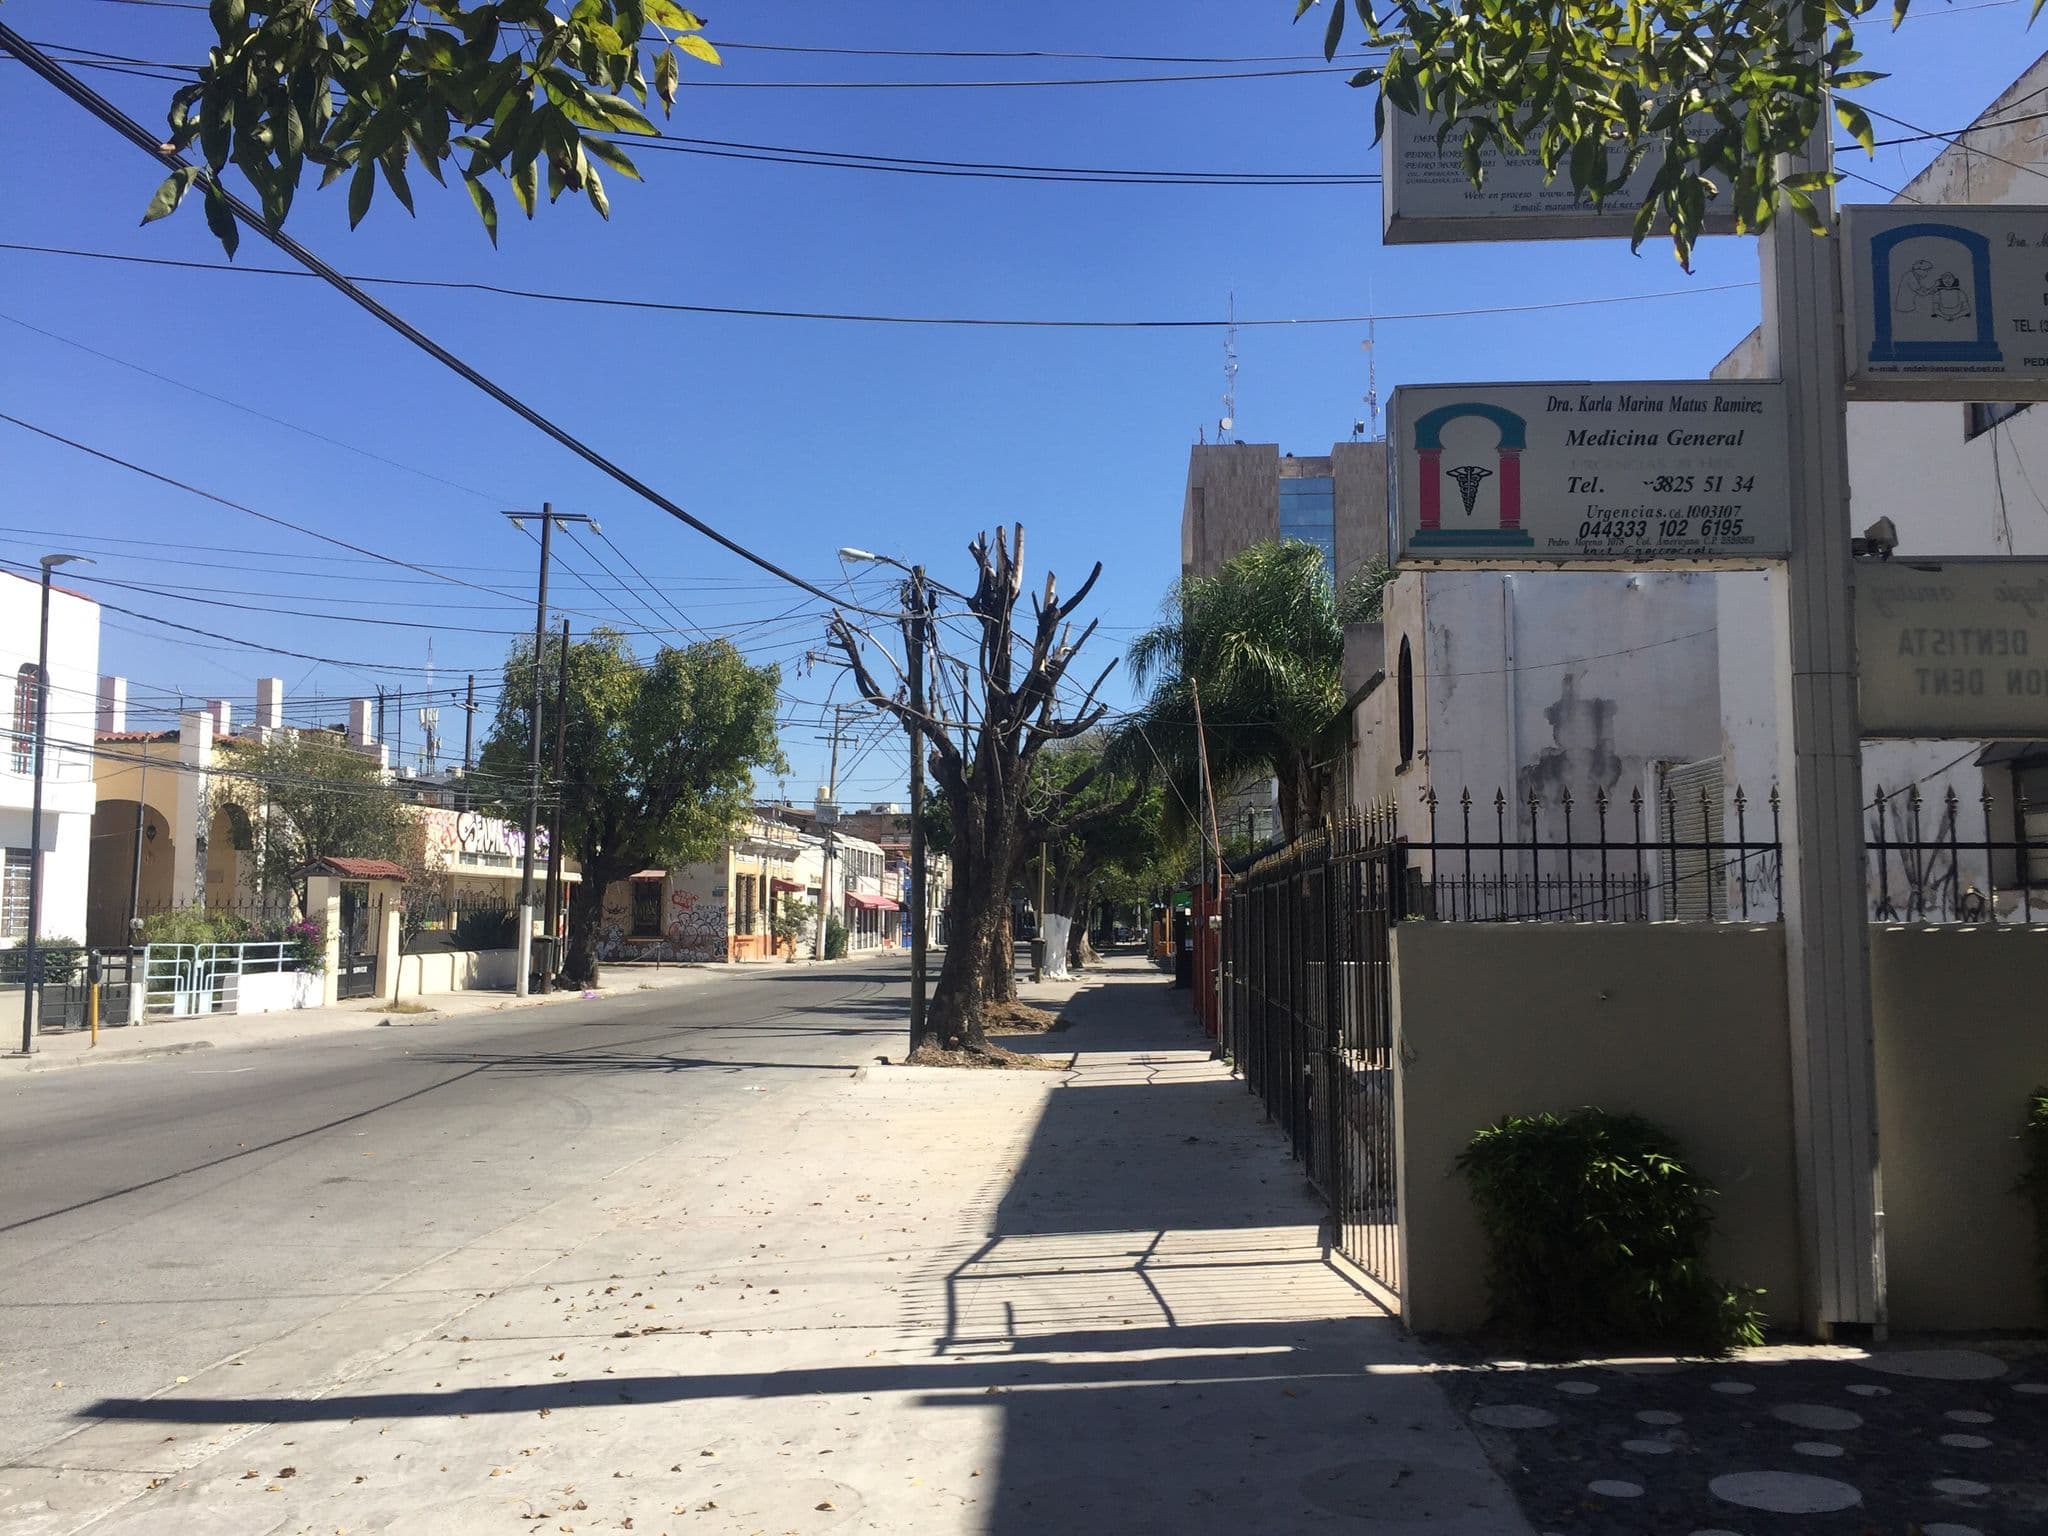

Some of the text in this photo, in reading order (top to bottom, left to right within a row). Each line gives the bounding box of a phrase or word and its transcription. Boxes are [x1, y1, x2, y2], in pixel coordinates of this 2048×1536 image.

[1546, 396, 1574, 413] Dra.
[1578, 395, 1612, 413] Karla
[1618, 395, 1664, 413] Marina
[1669, 396, 1708, 413] Matus
[1565, 429, 1745, 447] Medicina General
[1567, 476, 1605, 494] Tel.
[1703, 475, 1723, 493] 51
[1731, 475, 1754, 493] 34
[1579, 518, 1744, 539] 044333 102 6195
[1547, 537, 1570, 547] Pedro
